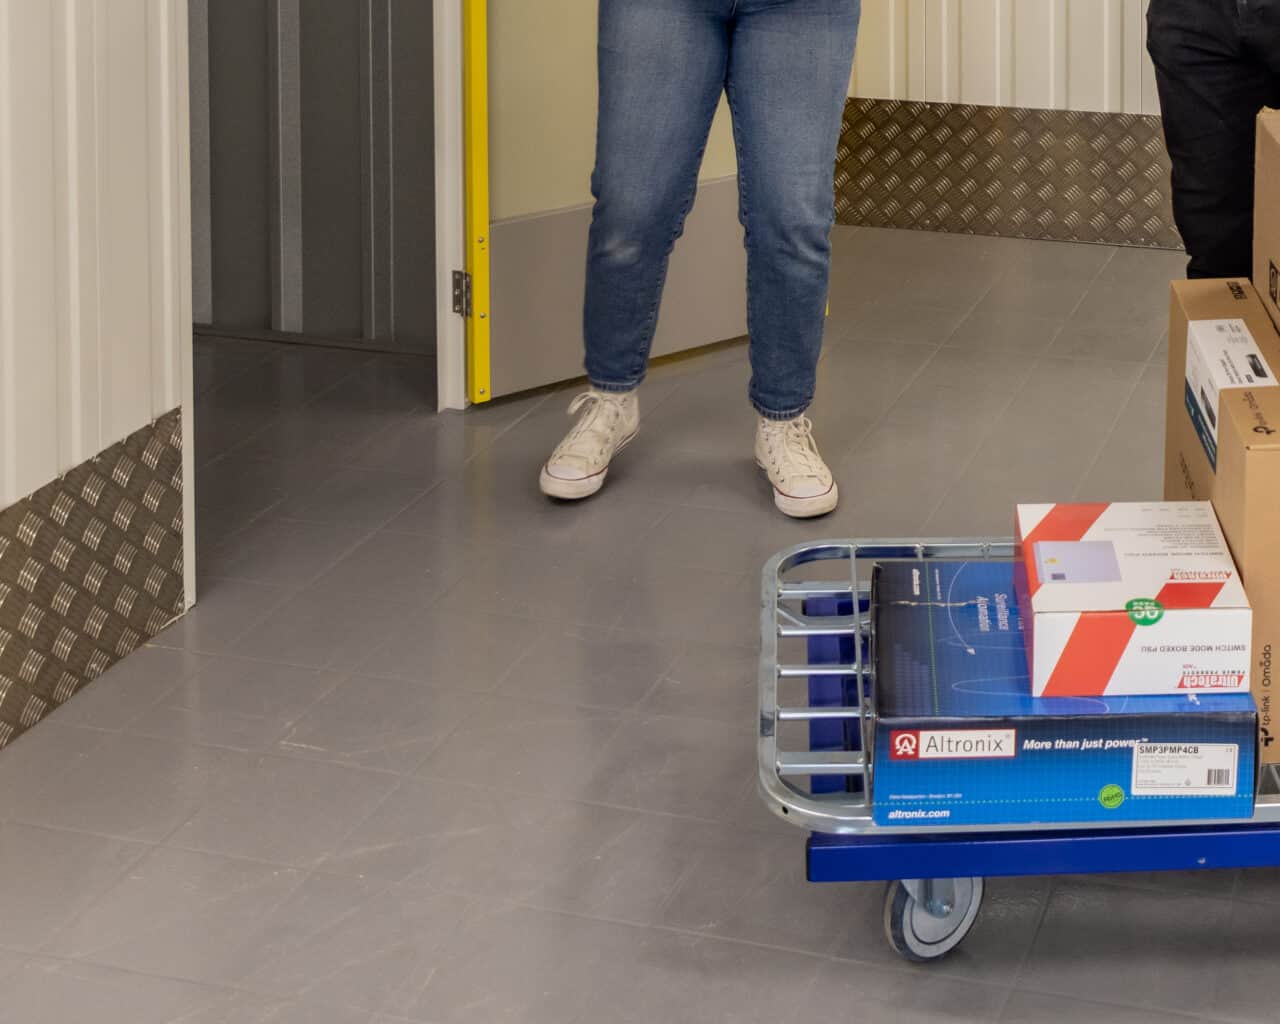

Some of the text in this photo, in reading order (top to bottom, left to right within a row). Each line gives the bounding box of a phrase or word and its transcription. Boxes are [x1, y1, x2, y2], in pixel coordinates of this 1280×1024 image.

[1160, 645, 1187, 653] BOXED
[1190, 645, 1213, 653] MODE
[1215, 644, 1246, 652] SWITCH
[925, 734, 1004, 754] Altronix
[1022, 739, 1052, 750] More
[1054, 738, 1080, 749] than
[1080, 737, 1103, 751] just
[887, 809, 951, 820] altronix.com
